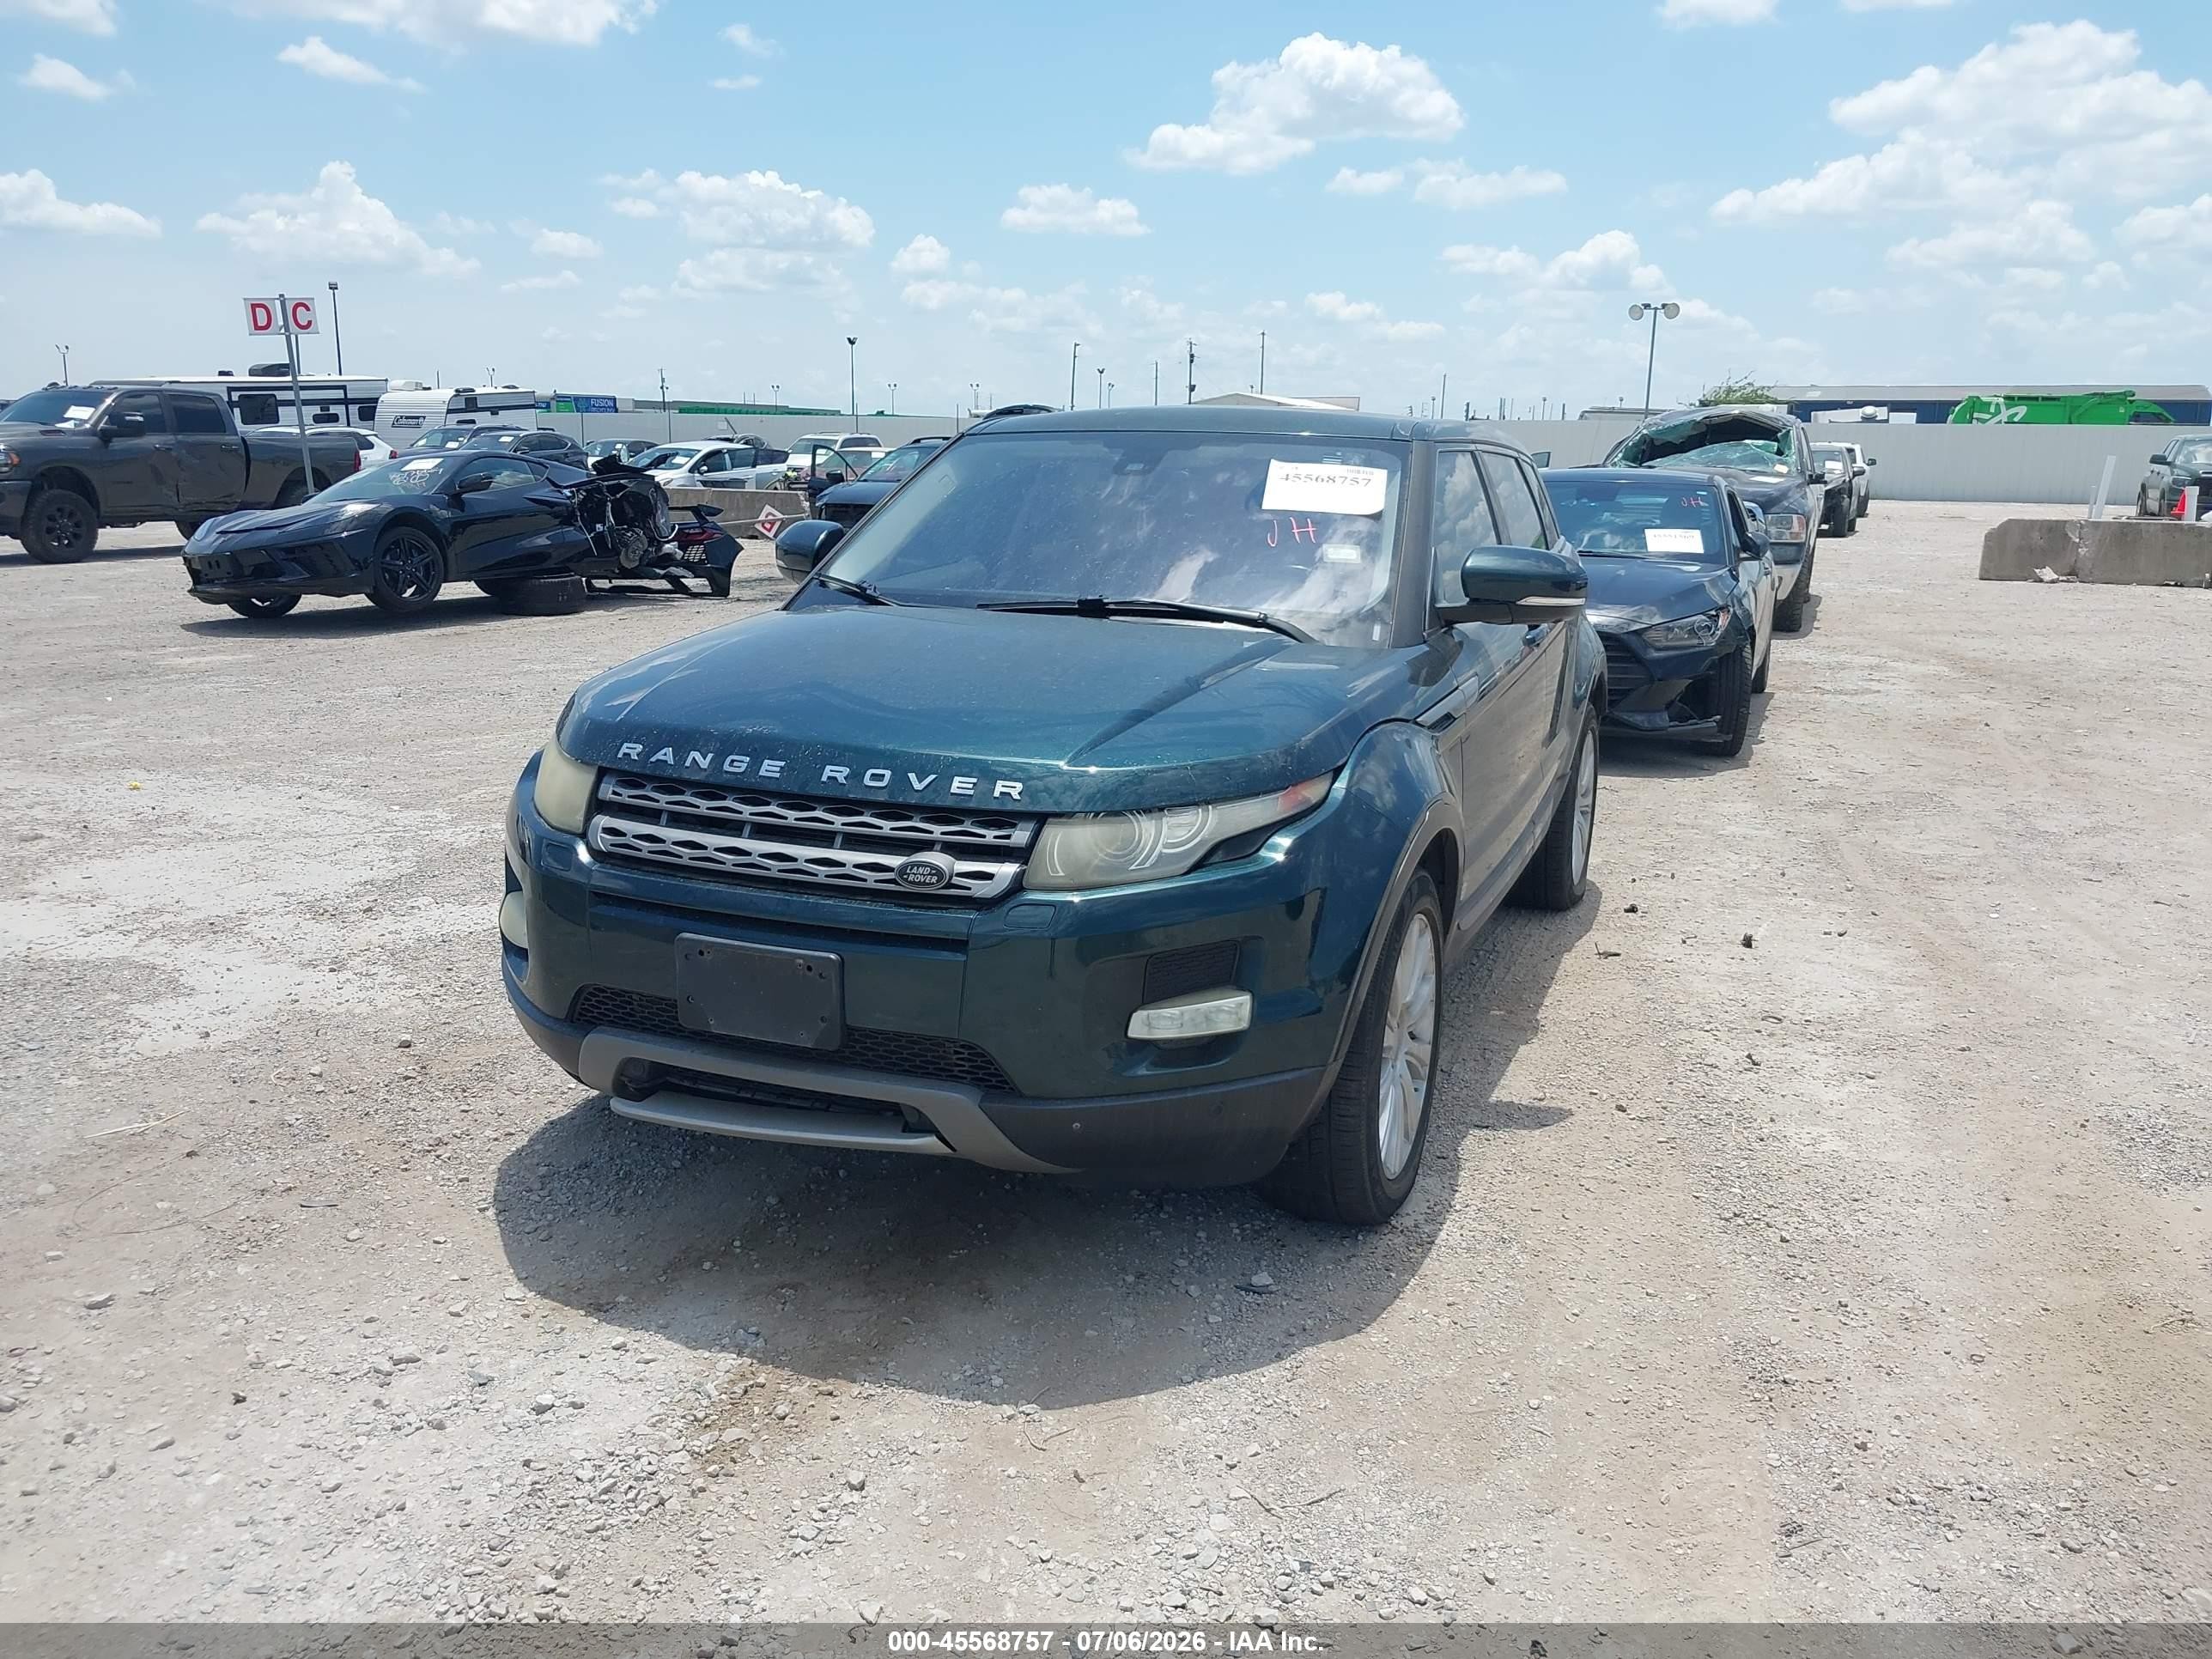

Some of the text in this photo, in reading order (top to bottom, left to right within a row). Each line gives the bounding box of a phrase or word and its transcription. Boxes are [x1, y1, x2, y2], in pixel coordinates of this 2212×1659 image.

[250, 302, 272, 331] D
[292, 301, 313, 331] C
[591, 398, 614, 407] FUSION
[1278, 473, 1372, 487] 45568757
[617, 742, 1024, 800] RANGE ROVER
[906, 865, 931, 875] LAND
[907, 873, 938, 884] ROVER
